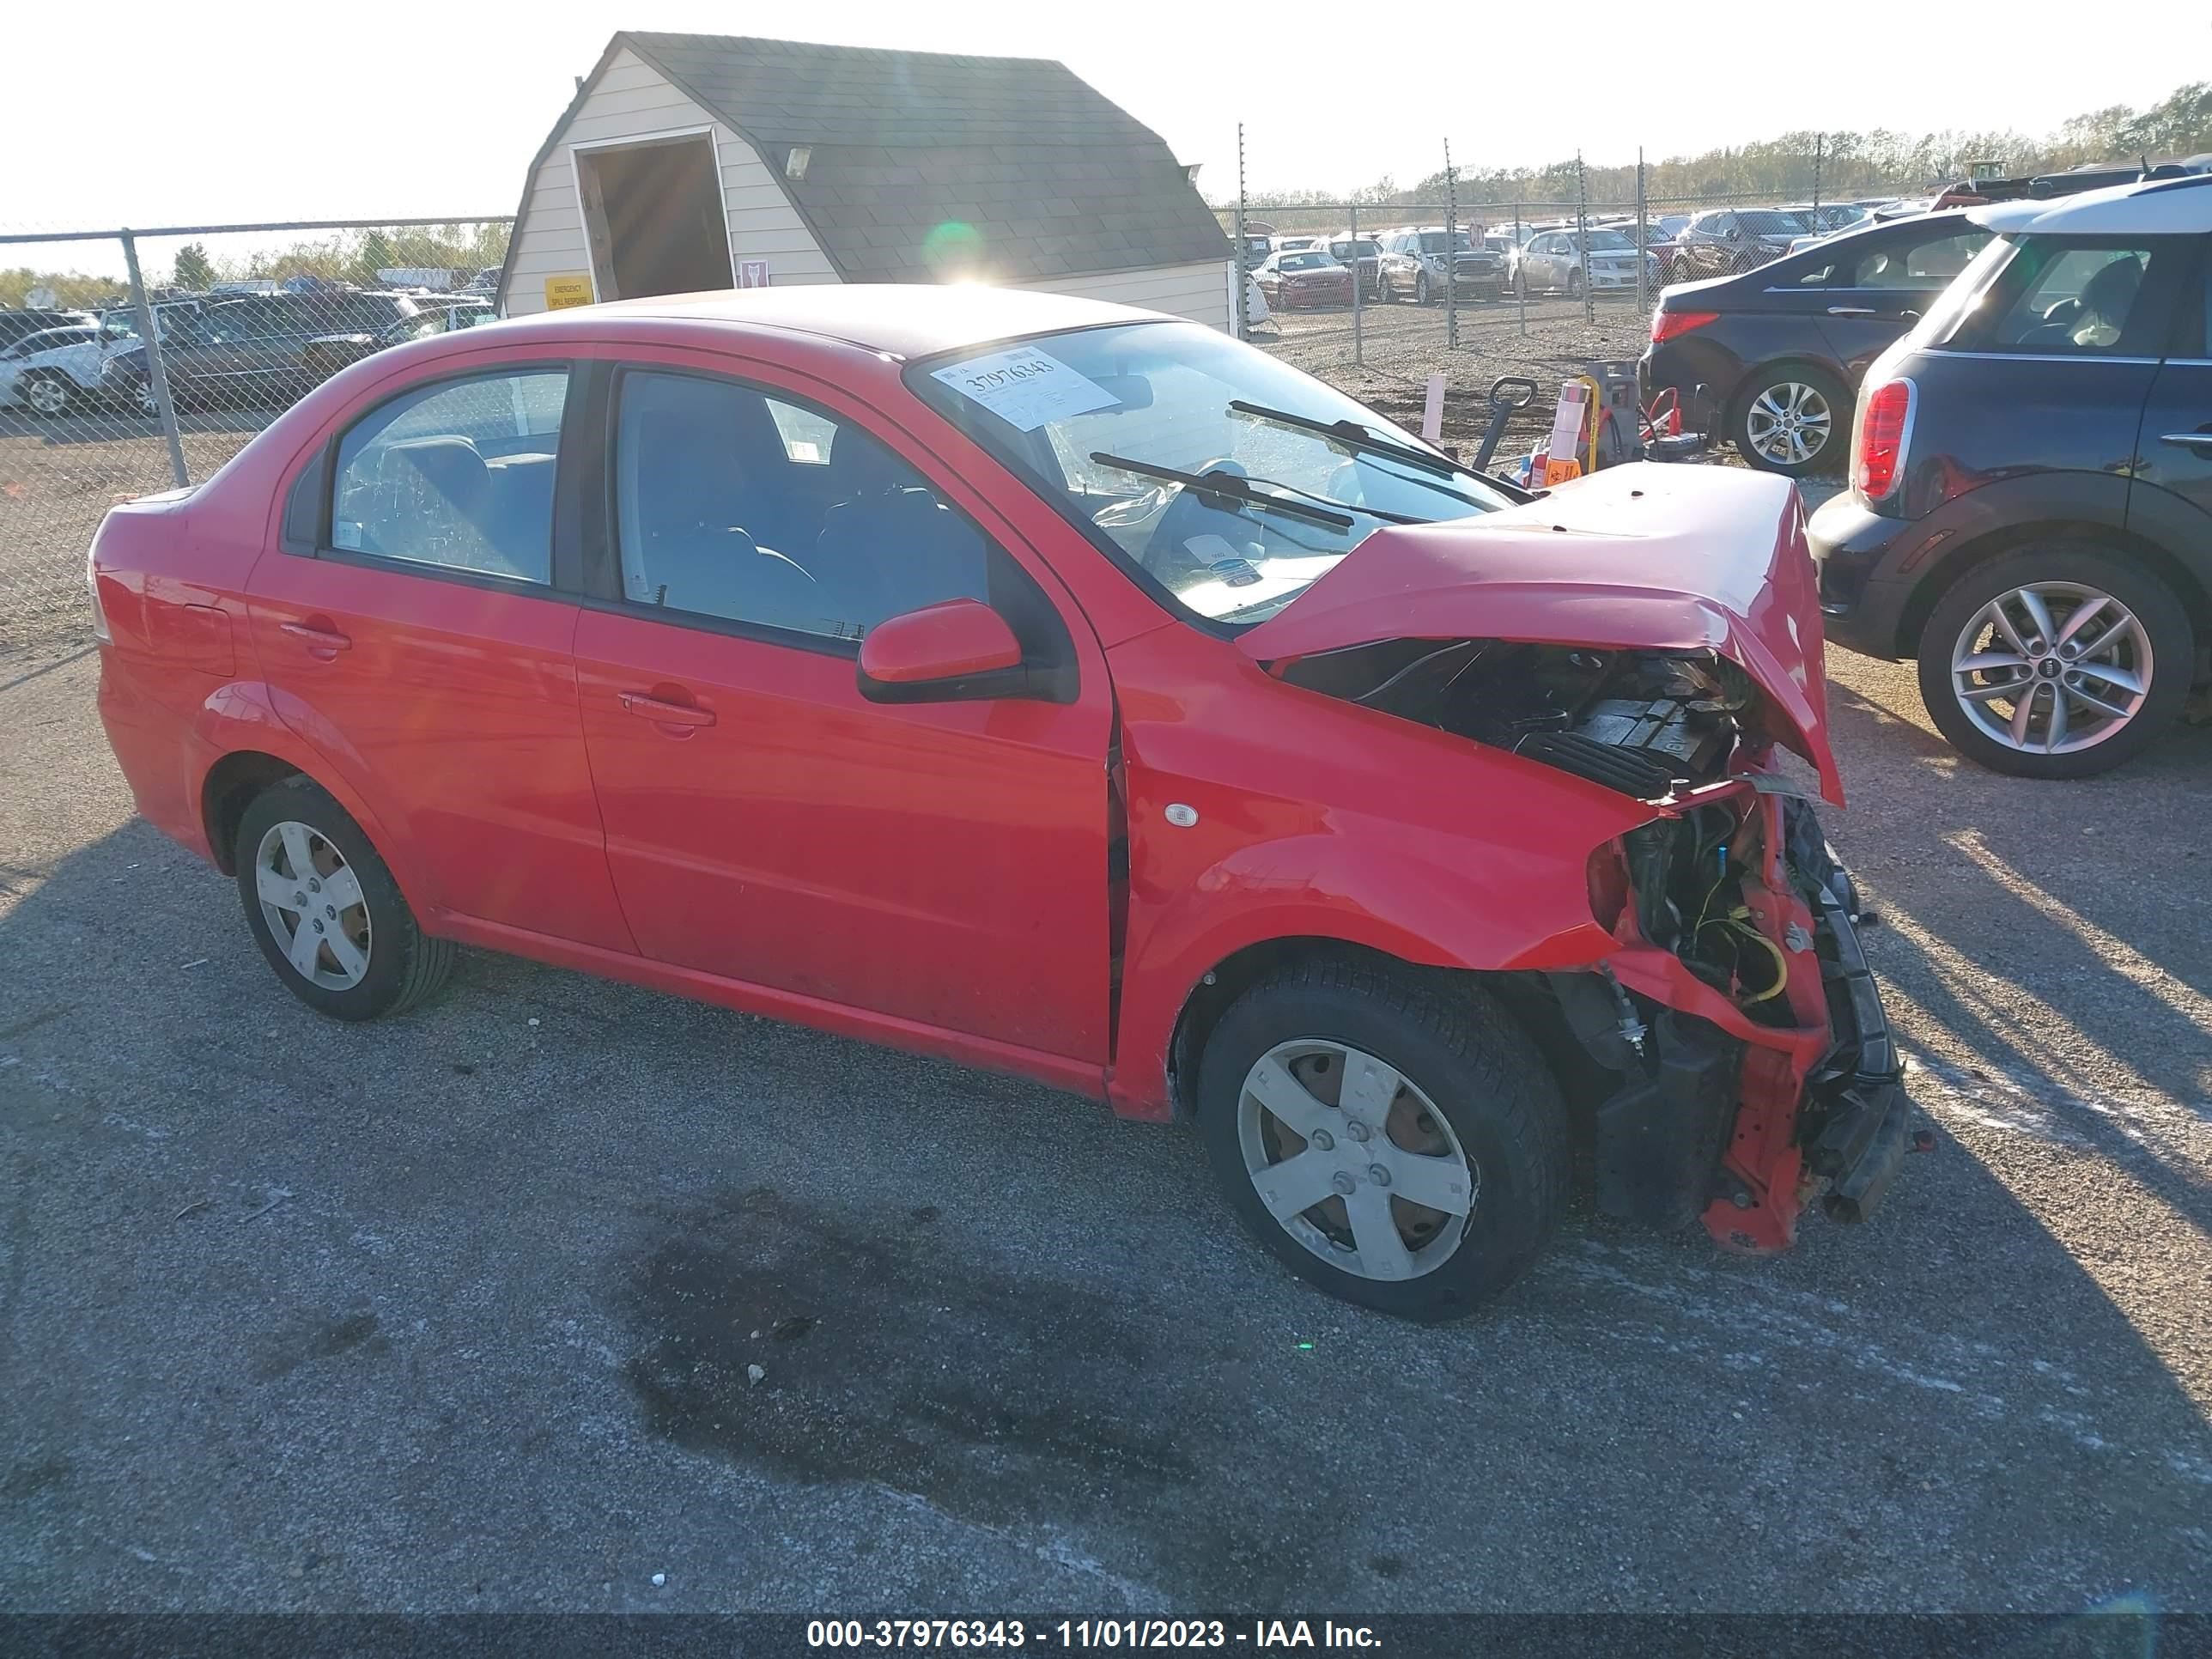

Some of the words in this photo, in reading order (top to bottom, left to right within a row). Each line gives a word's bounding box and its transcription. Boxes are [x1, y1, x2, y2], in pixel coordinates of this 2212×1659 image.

[554, 284, 581, 293] EMERGENCY
[564, 296, 588, 305] RESPONSE
[966, 361, 1054, 392] 37976343
